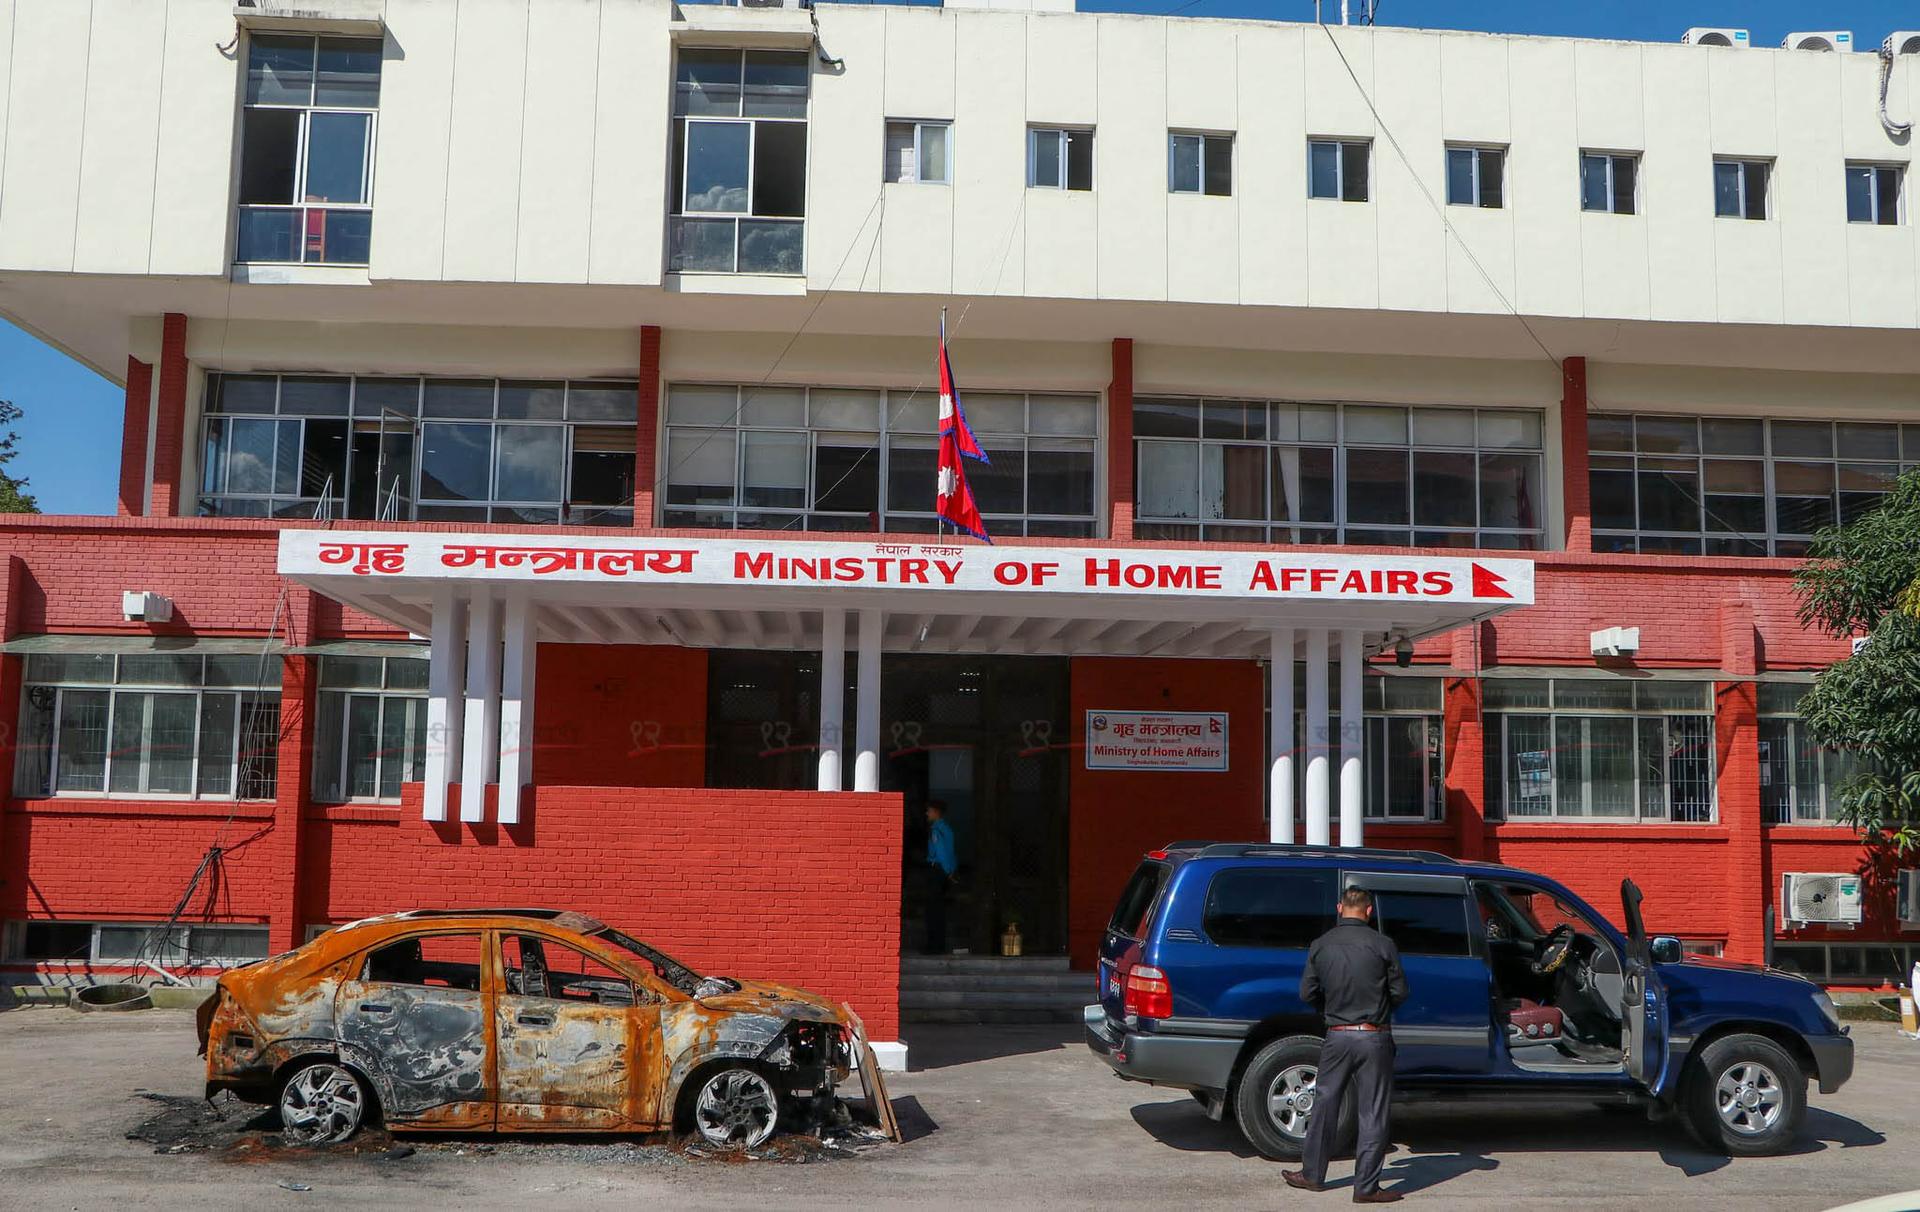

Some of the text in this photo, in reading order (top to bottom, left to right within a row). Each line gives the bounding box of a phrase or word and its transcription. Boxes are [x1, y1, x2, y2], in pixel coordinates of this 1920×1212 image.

[876, 543, 964, 558] नेपाल सरकार
[319, 542, 700, 577] गृह मन्त्रालय
[734, 551, 1455, 596] MINISTRY OF HOME AFFAIRS
[1113, 723, 1202, 738] गृह मन्त्रालय
[1094, 745, 1220, 758] Ministry of Home Affairs
